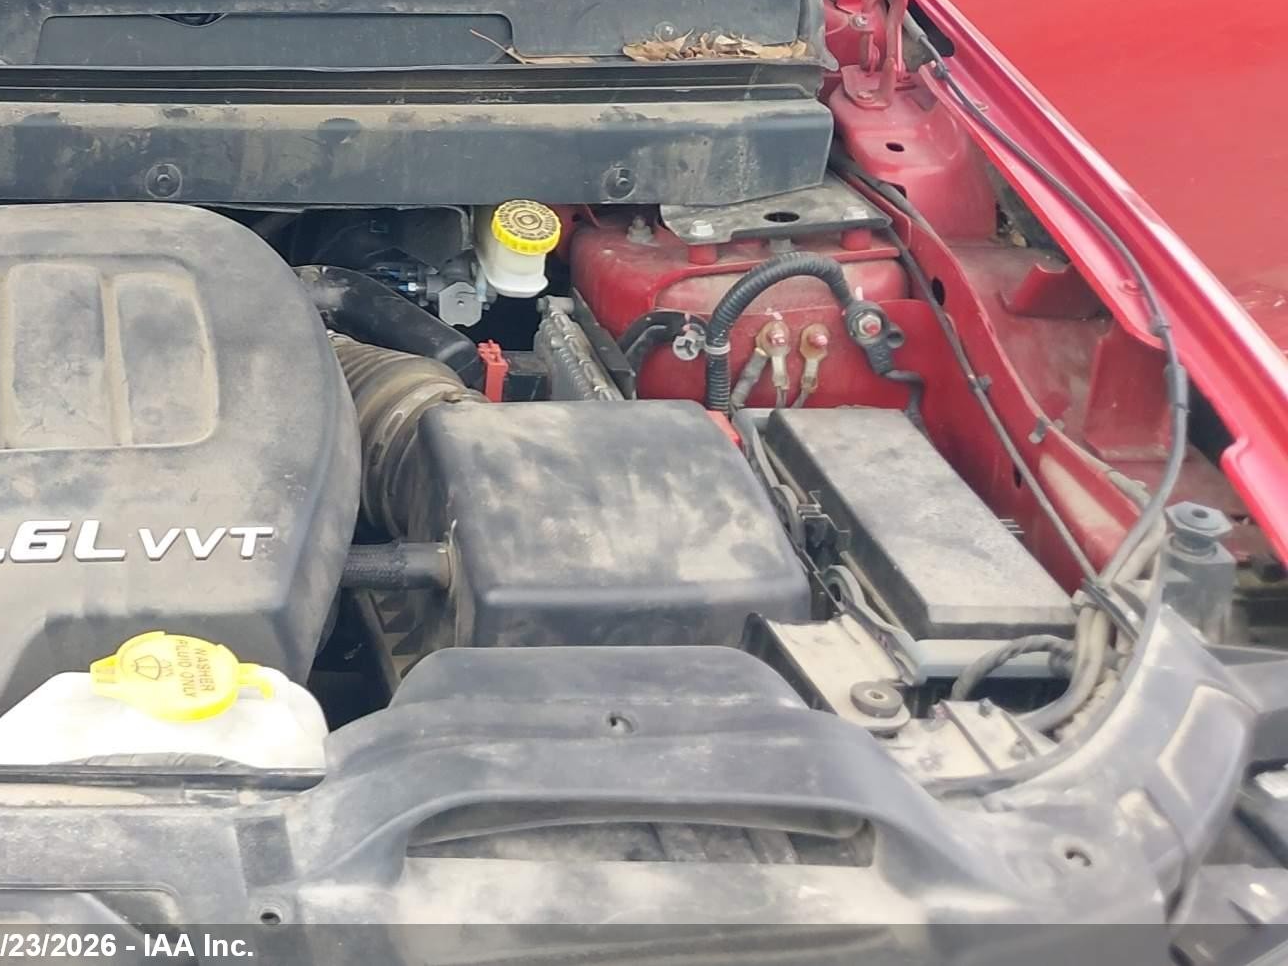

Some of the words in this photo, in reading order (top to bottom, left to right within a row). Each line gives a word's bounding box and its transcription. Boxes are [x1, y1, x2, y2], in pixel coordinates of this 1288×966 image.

[138, 526, 274, 561] VVT
[175, 639, 193, 668] FLUID
[193, 648, 216, 691] WASHER
[180, 671, 197, 699] ONLY
